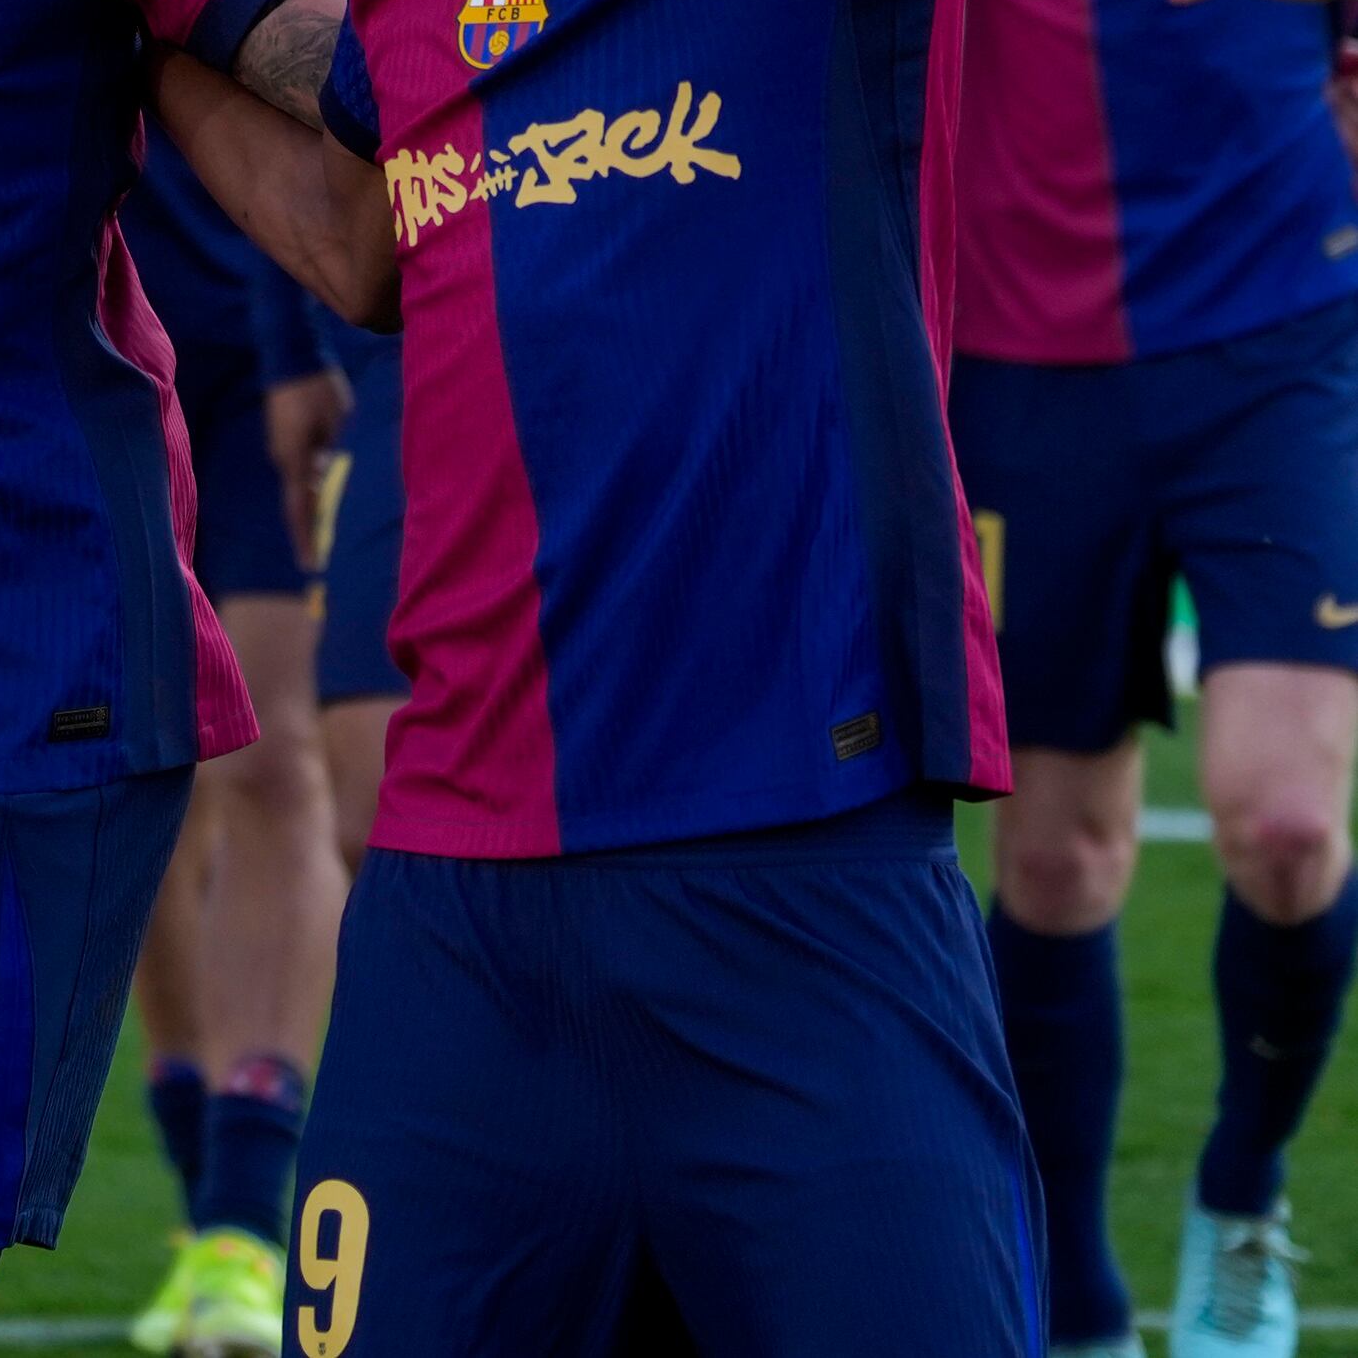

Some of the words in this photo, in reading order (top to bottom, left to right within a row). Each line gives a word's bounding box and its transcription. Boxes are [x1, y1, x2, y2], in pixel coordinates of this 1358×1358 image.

[486, 7, 521, 21] FCB
[507, 80, 742, 209] Jack
[297, 1178, 370, 1358] 9
